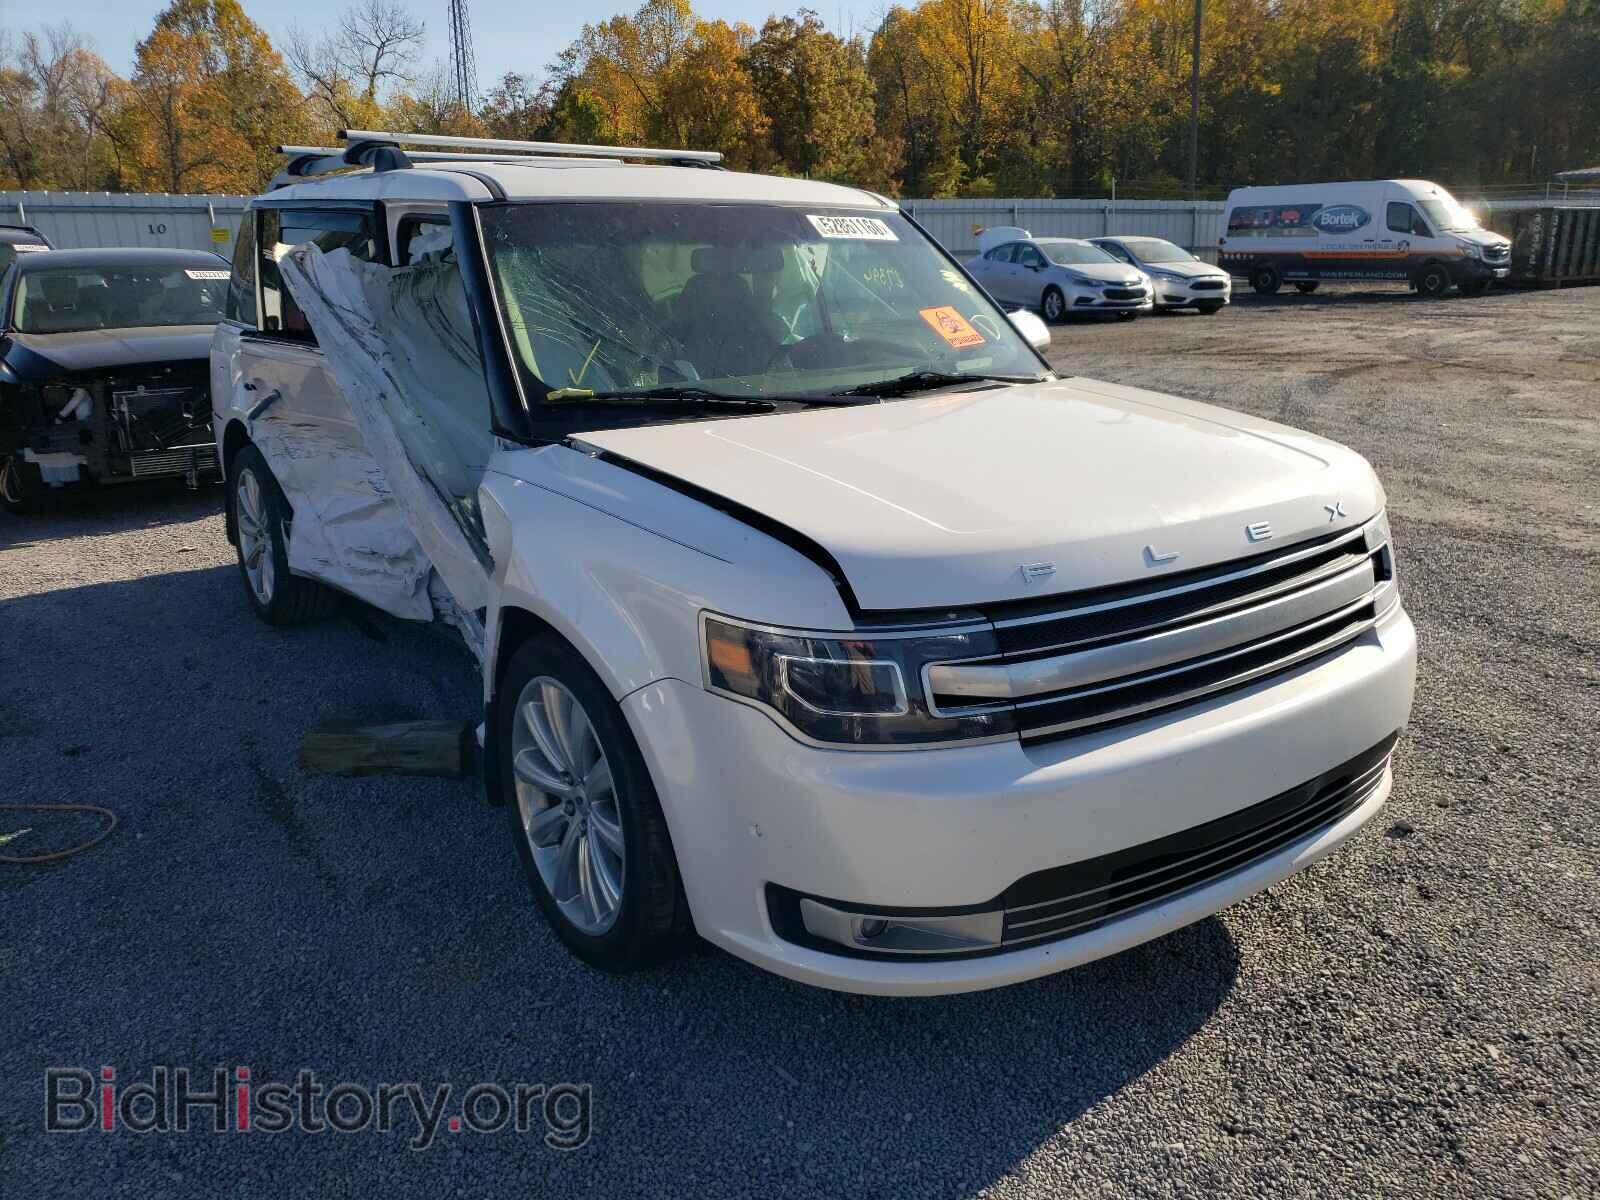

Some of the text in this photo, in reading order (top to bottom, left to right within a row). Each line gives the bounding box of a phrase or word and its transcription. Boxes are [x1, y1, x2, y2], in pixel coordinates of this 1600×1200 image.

[1320, 210, 1360, 228] Bortek
[148, 223, 167, 235] 10
[1016, 500, 1346, 584] FLEX
